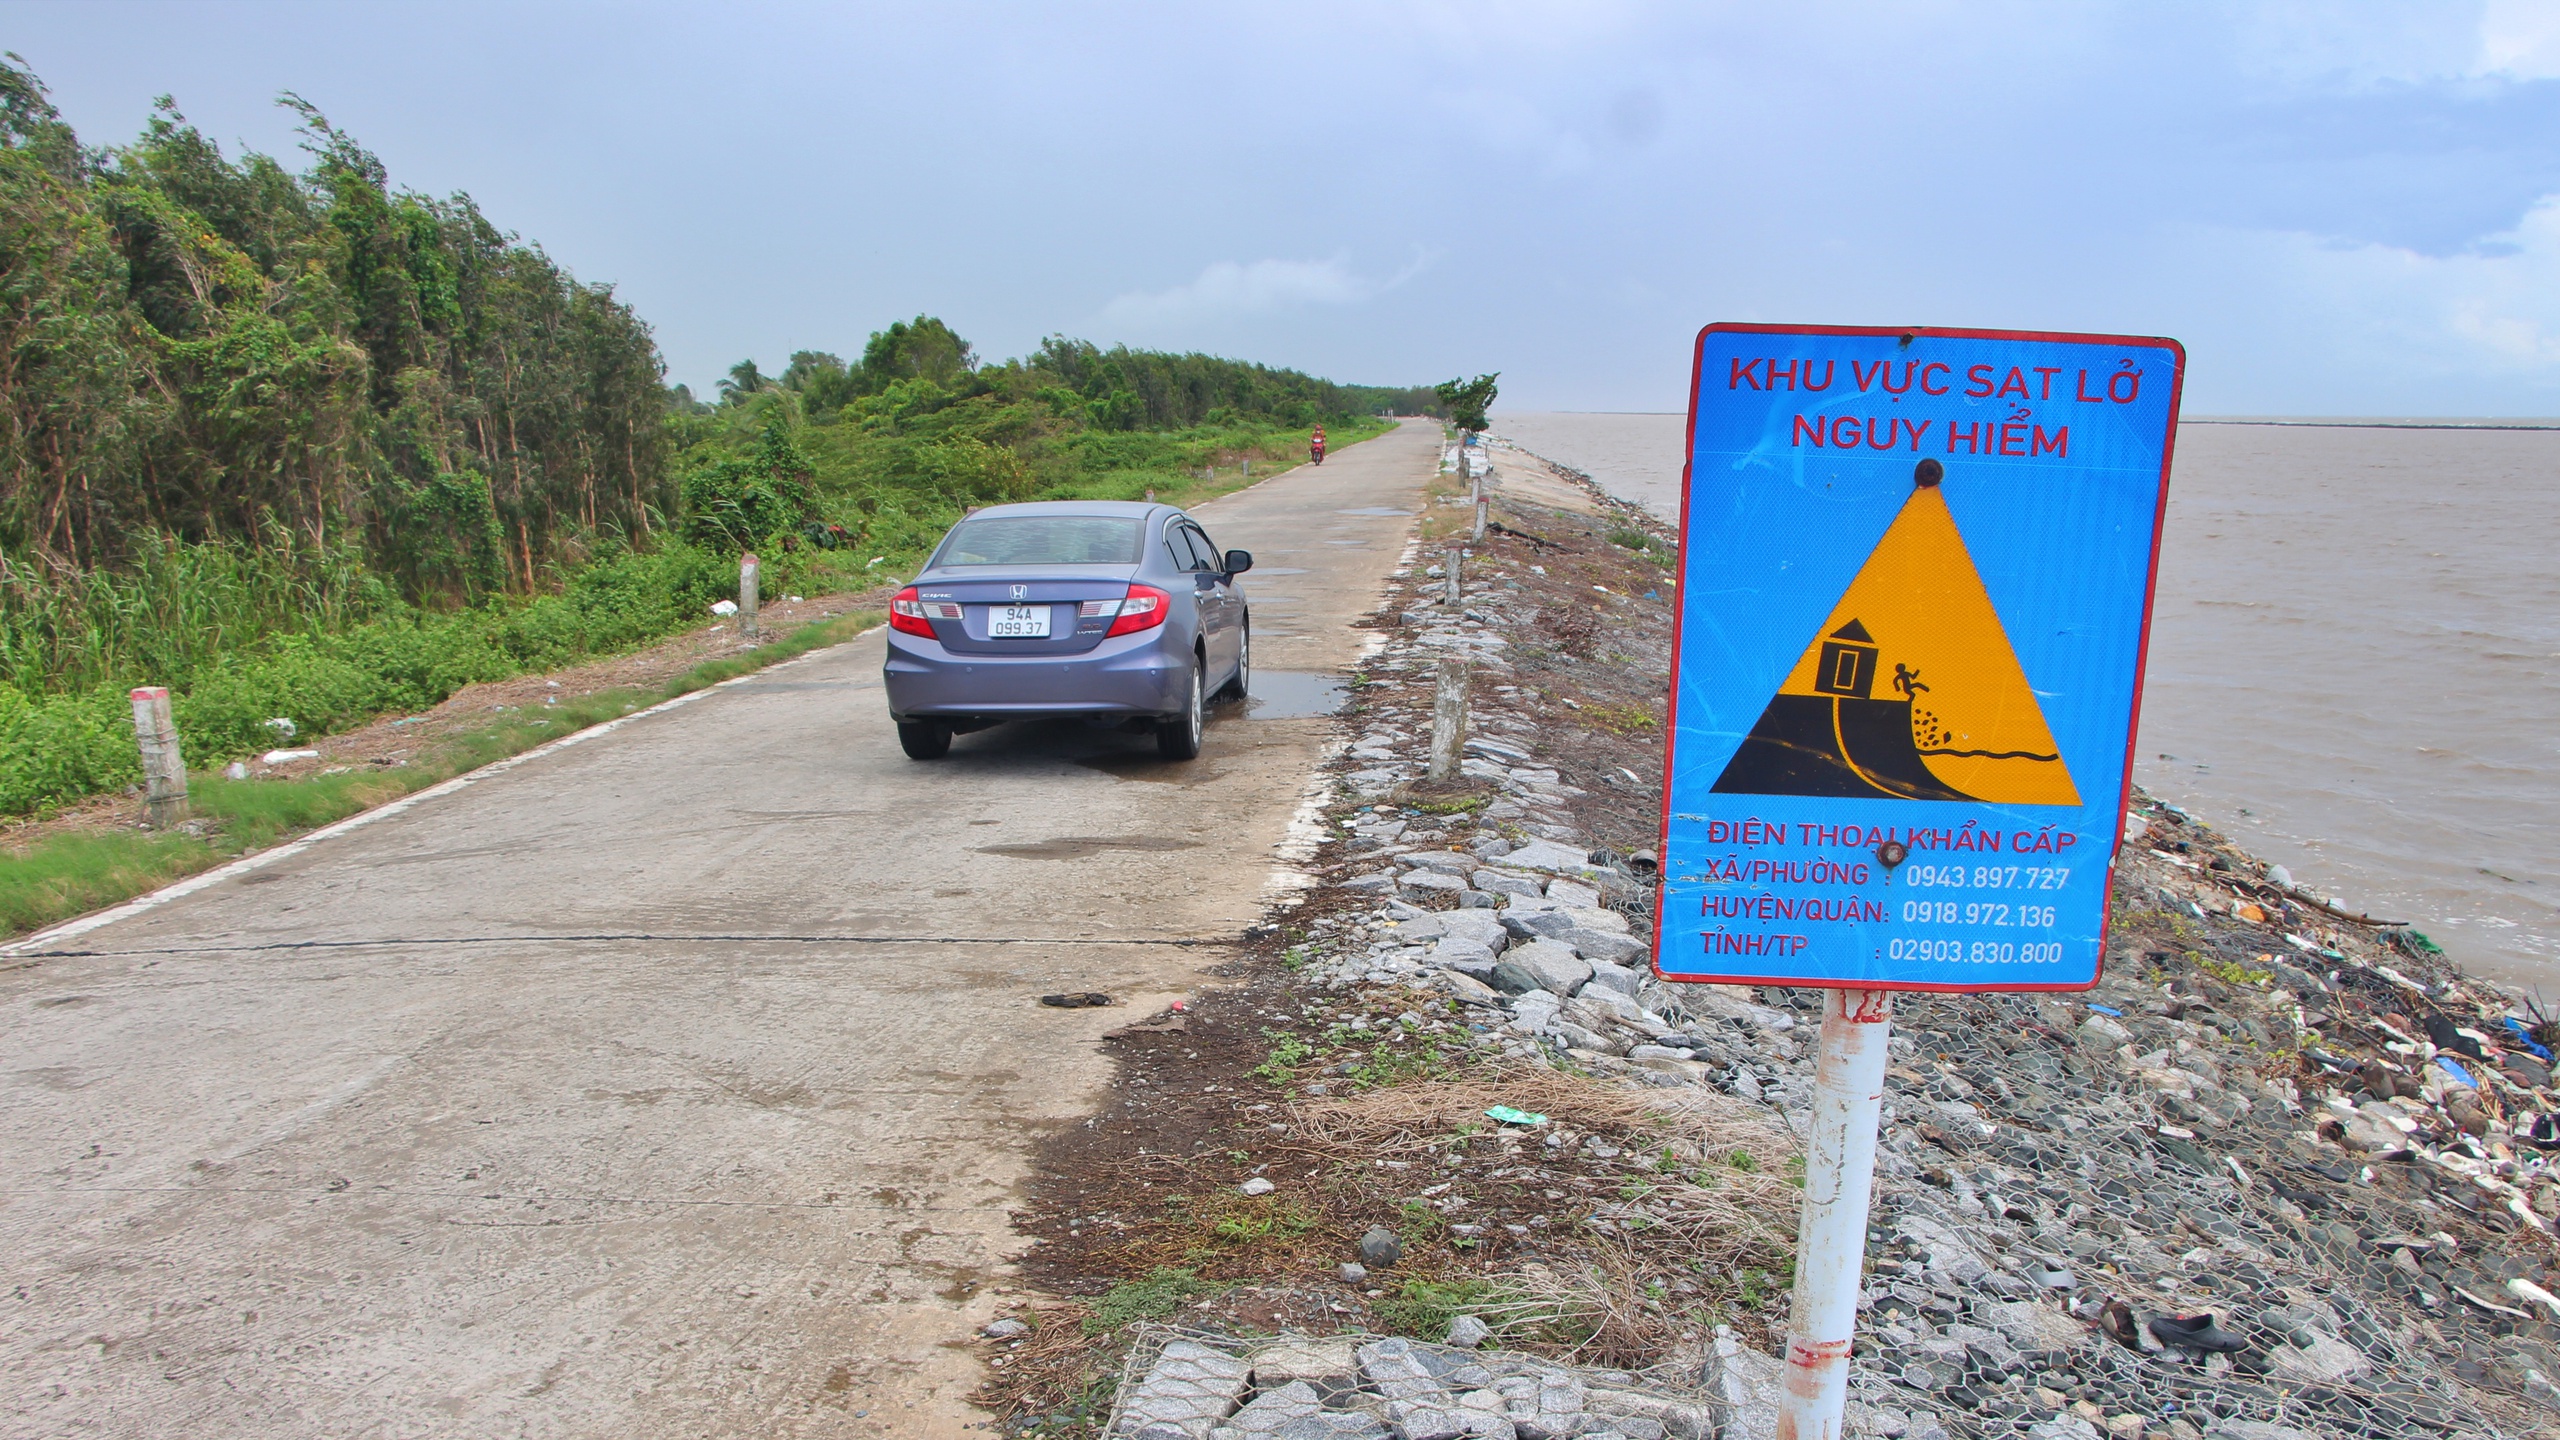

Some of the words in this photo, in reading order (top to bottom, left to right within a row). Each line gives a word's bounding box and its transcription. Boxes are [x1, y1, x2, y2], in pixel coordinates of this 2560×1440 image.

[1728, 357, 1835, 392] KHU
[1851, 358, 1951, 403] VỰC
[1965, 364, 2062, 408] SẠT
[2076, 358, 2144, 404] LỞ
[1792, 413, 1931, 451] NGUY
[1947, 408, 2070, 458] HIỂM
[995, 622, 1042, 635] 099.37
[1007, 608, 1031, 620] 94A
[1707, 817, 1787, 849] ĐIỆN
[1797, 823, 1896, 853] THOẠI
[1906, 819, 2001, 854] KHẨN
[2012, 823, 2077, 854] CẤP
[1705, 857, 1869, 886] XÃ/PHƯỜNG
[1906, 865, 2070, 890] 0943.897.727
[1902, 901, 2056, 927] 0918.972.136
[1700, 925, 1809, 957] TỈNH/TP
[1888, 938, 2062, 963] 02903.830.800
